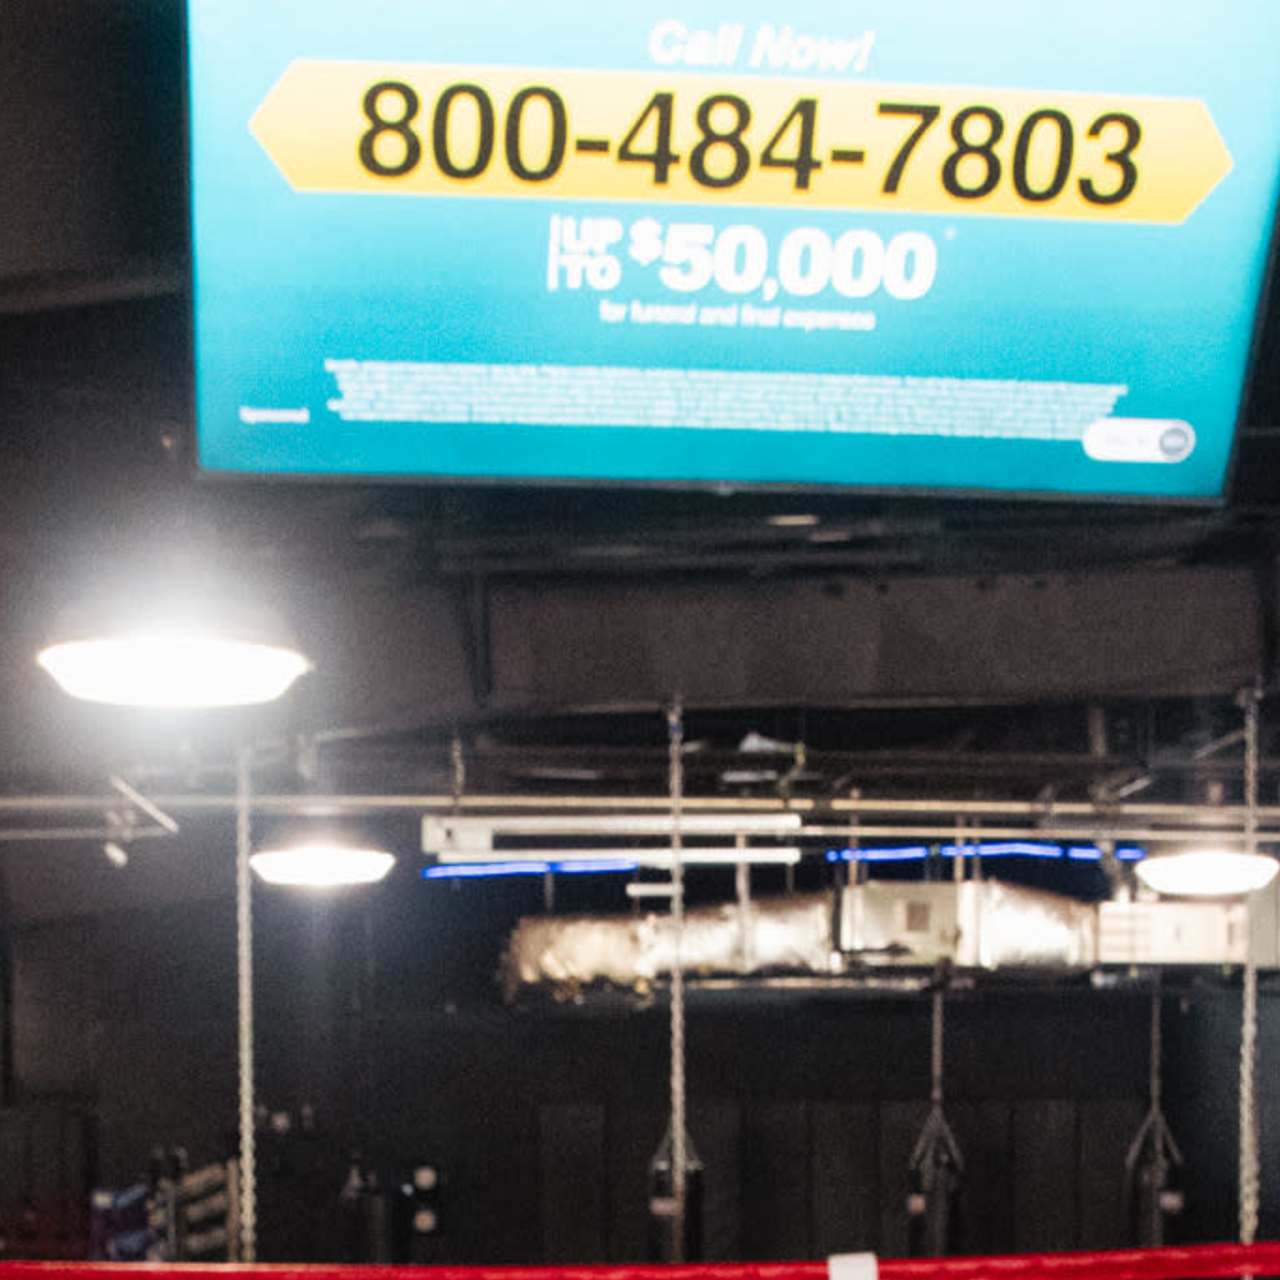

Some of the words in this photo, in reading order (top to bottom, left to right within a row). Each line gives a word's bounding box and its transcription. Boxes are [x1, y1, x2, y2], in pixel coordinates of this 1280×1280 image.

[648, 19, 744, 66] Call
[749, 24, 877, 73] Now!
[356, 80, 1144, 207] 800-484-7803
[560, 253, 622, 290] TO
